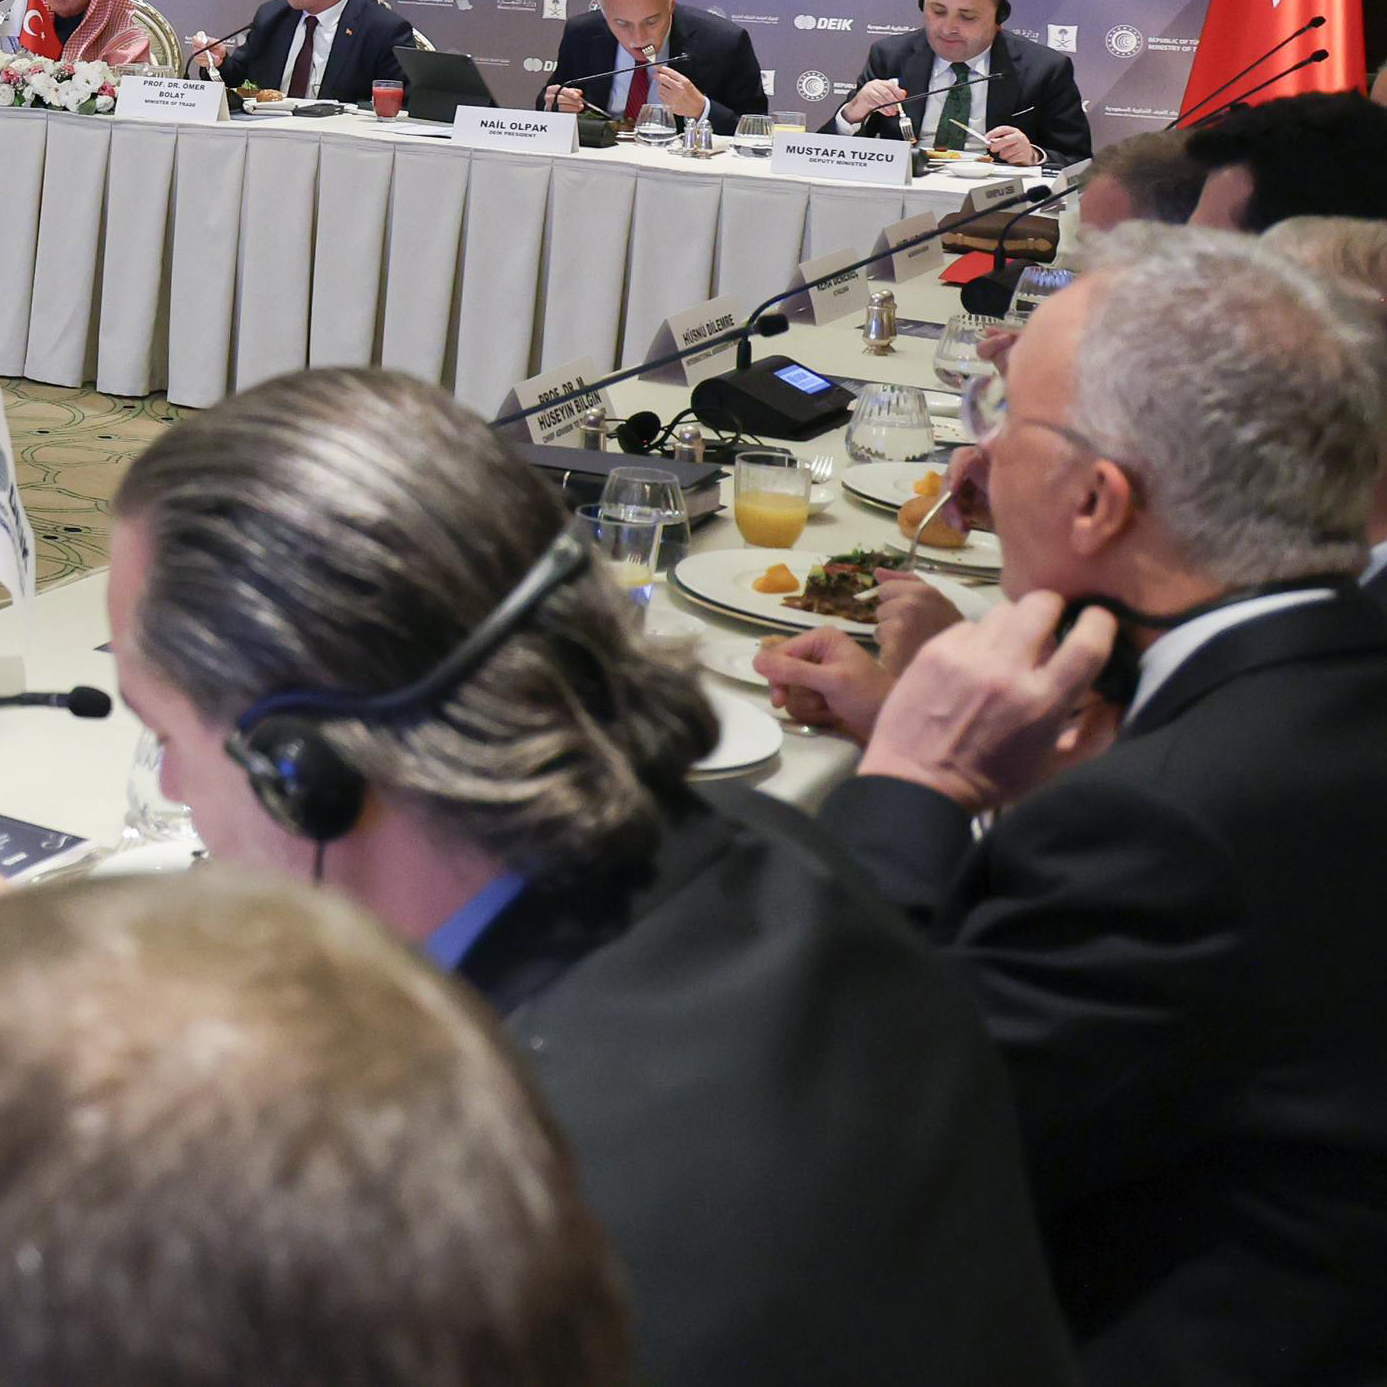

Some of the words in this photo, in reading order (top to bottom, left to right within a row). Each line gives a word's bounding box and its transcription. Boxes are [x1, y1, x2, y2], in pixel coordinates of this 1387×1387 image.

[143, 80, 165, 88] PROF.
[159, 91, 185, 99] BOLAT
[480, 119, 507, 130] NAİL
[509, 122, 547, 133] OLPAK
[785, 145, 845, 159] MUSTAFA
[850, 149, 895, 163] TUZCU
[809, 157, 835, 165] DEPUTY
[836, 159, 868, 167] MINISTER
